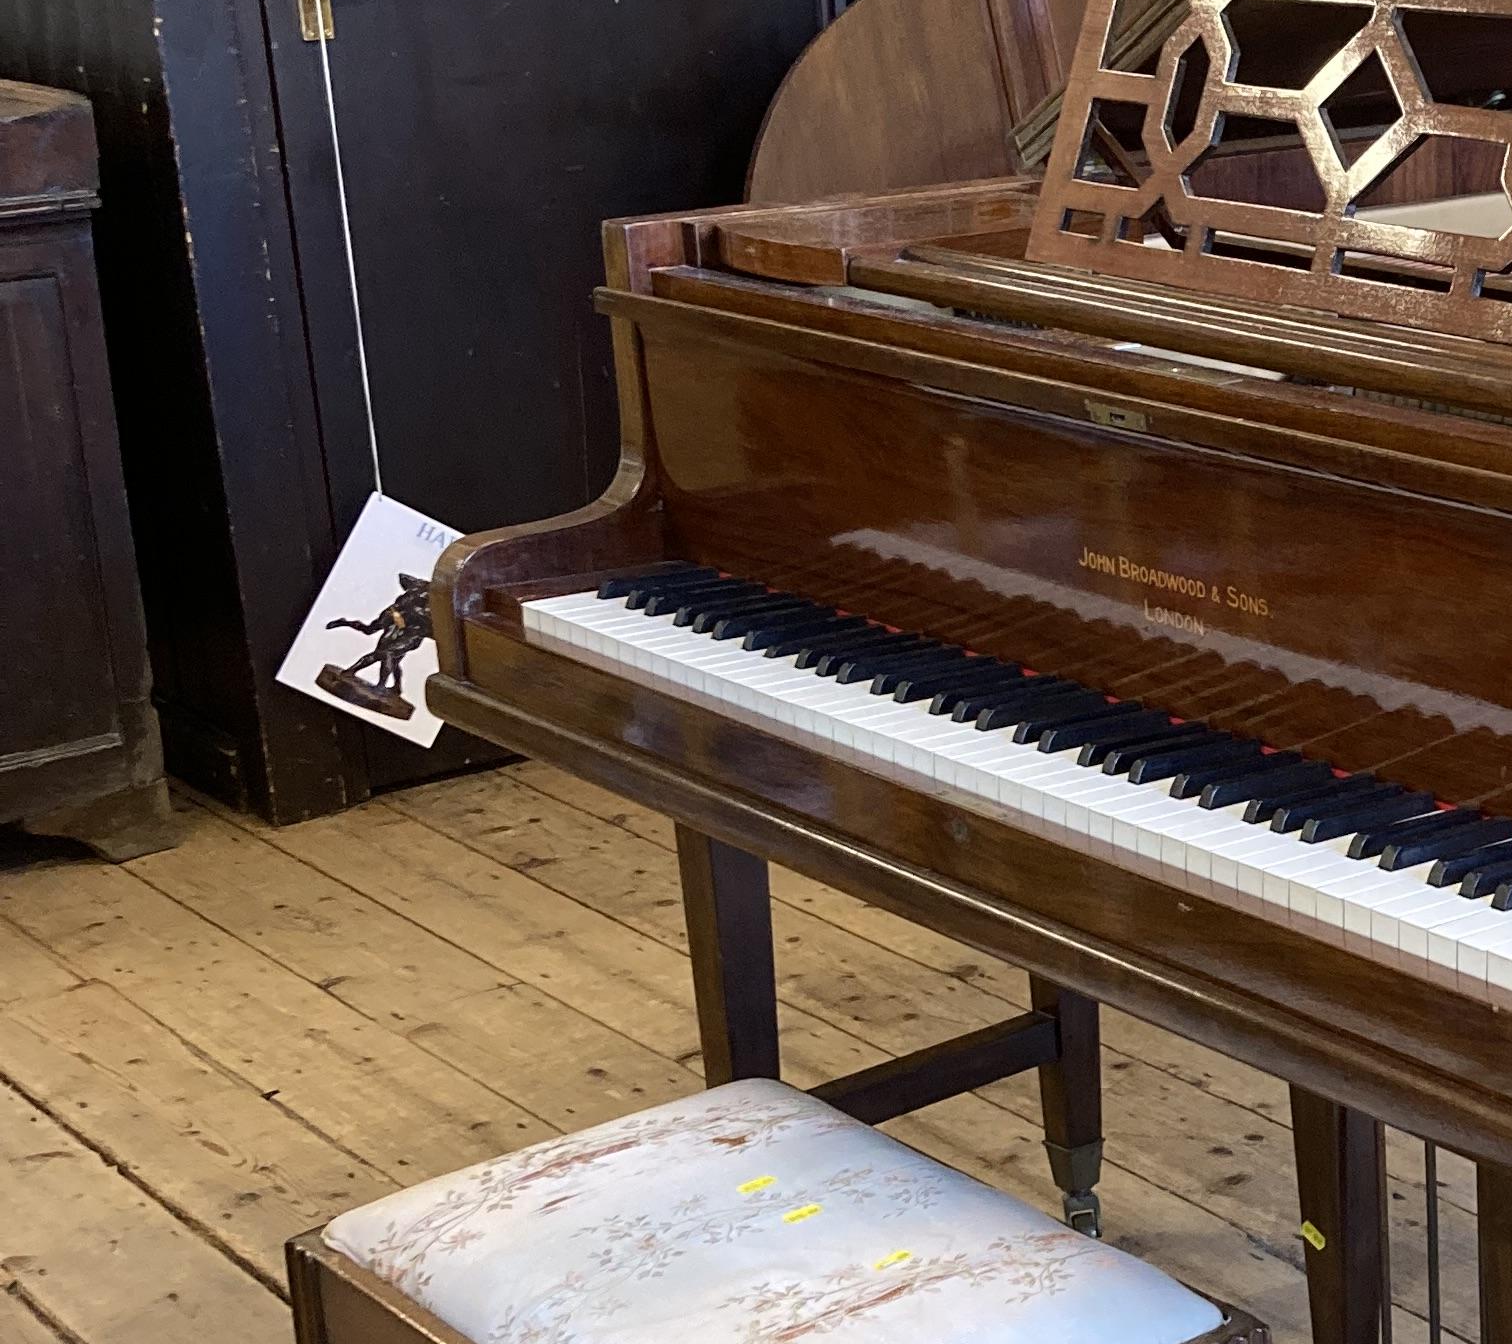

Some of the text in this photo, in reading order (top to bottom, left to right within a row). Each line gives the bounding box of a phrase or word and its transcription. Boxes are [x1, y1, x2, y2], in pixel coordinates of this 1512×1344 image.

[1078, 546, 1116, 575] JOHN
[1119, 556, 1206, 598] BROADWOOD
[1211, 585, 1221, 605] &
[1144, 598, 1204, 637] LONDON
